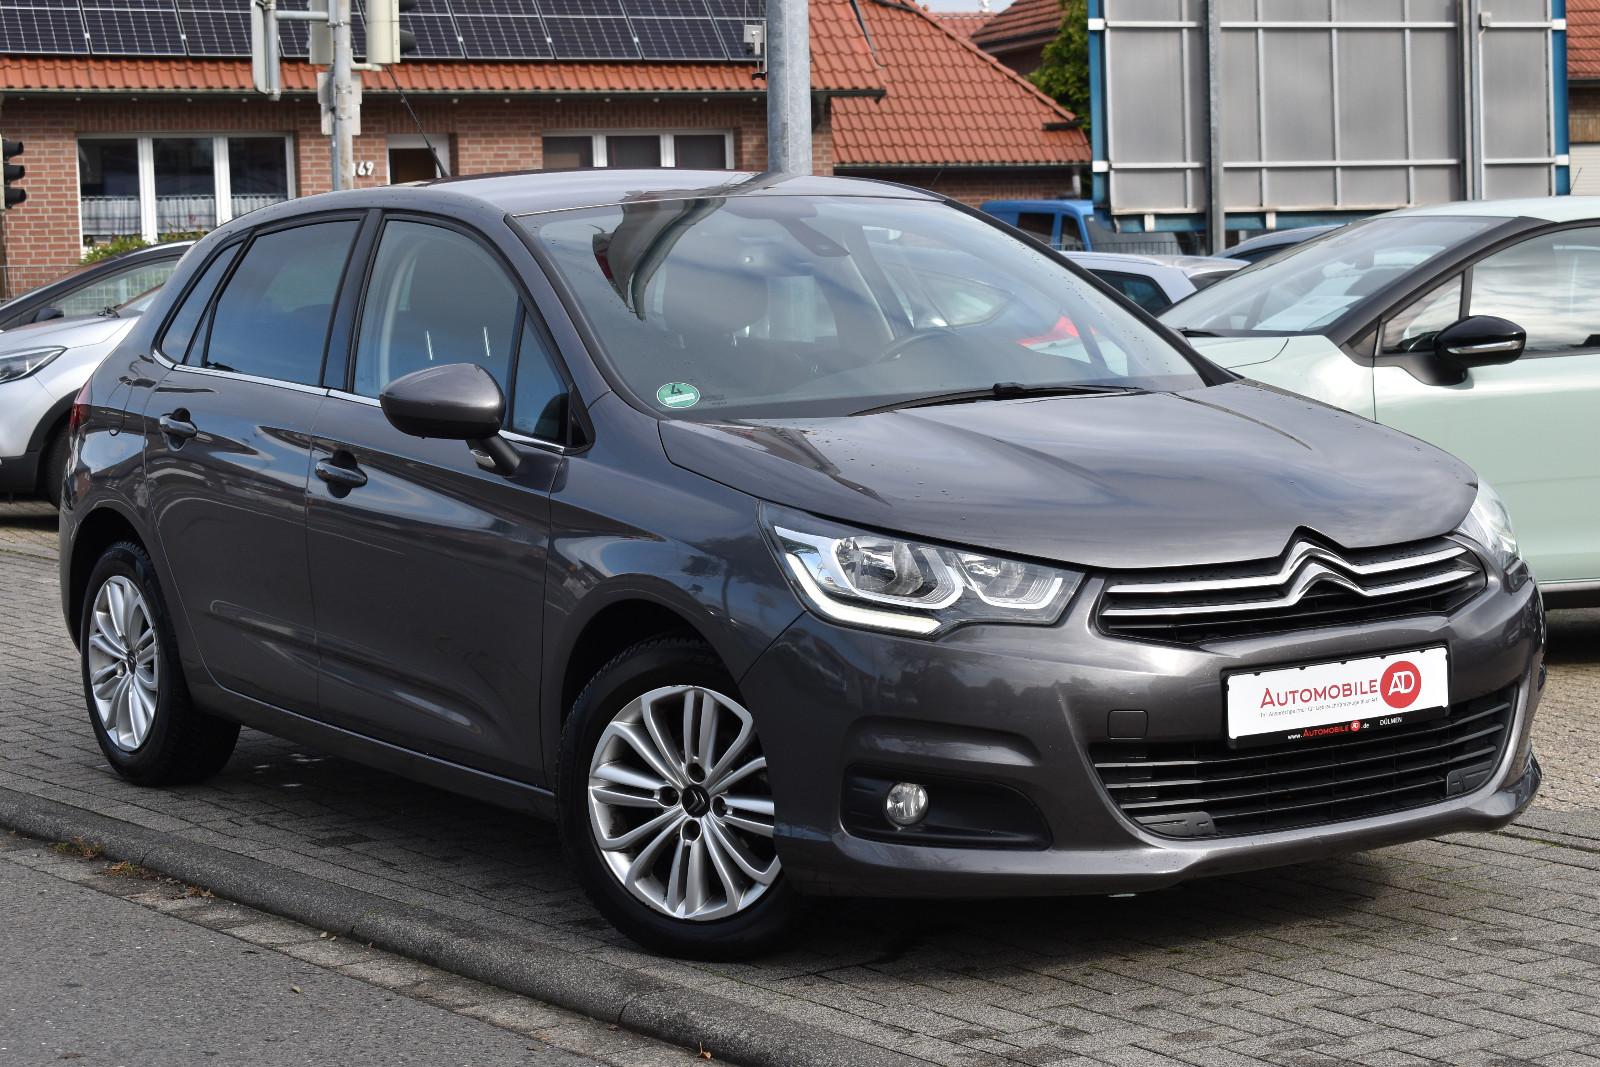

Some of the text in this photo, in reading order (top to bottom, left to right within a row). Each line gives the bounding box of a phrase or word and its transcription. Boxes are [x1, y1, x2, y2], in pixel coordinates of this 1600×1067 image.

[1260, 679, 1378, 708] AUTOMOBILE
[1388, 670, 1415, 696] AD
[1379, 717, 1402, 726] DÜLMEN
